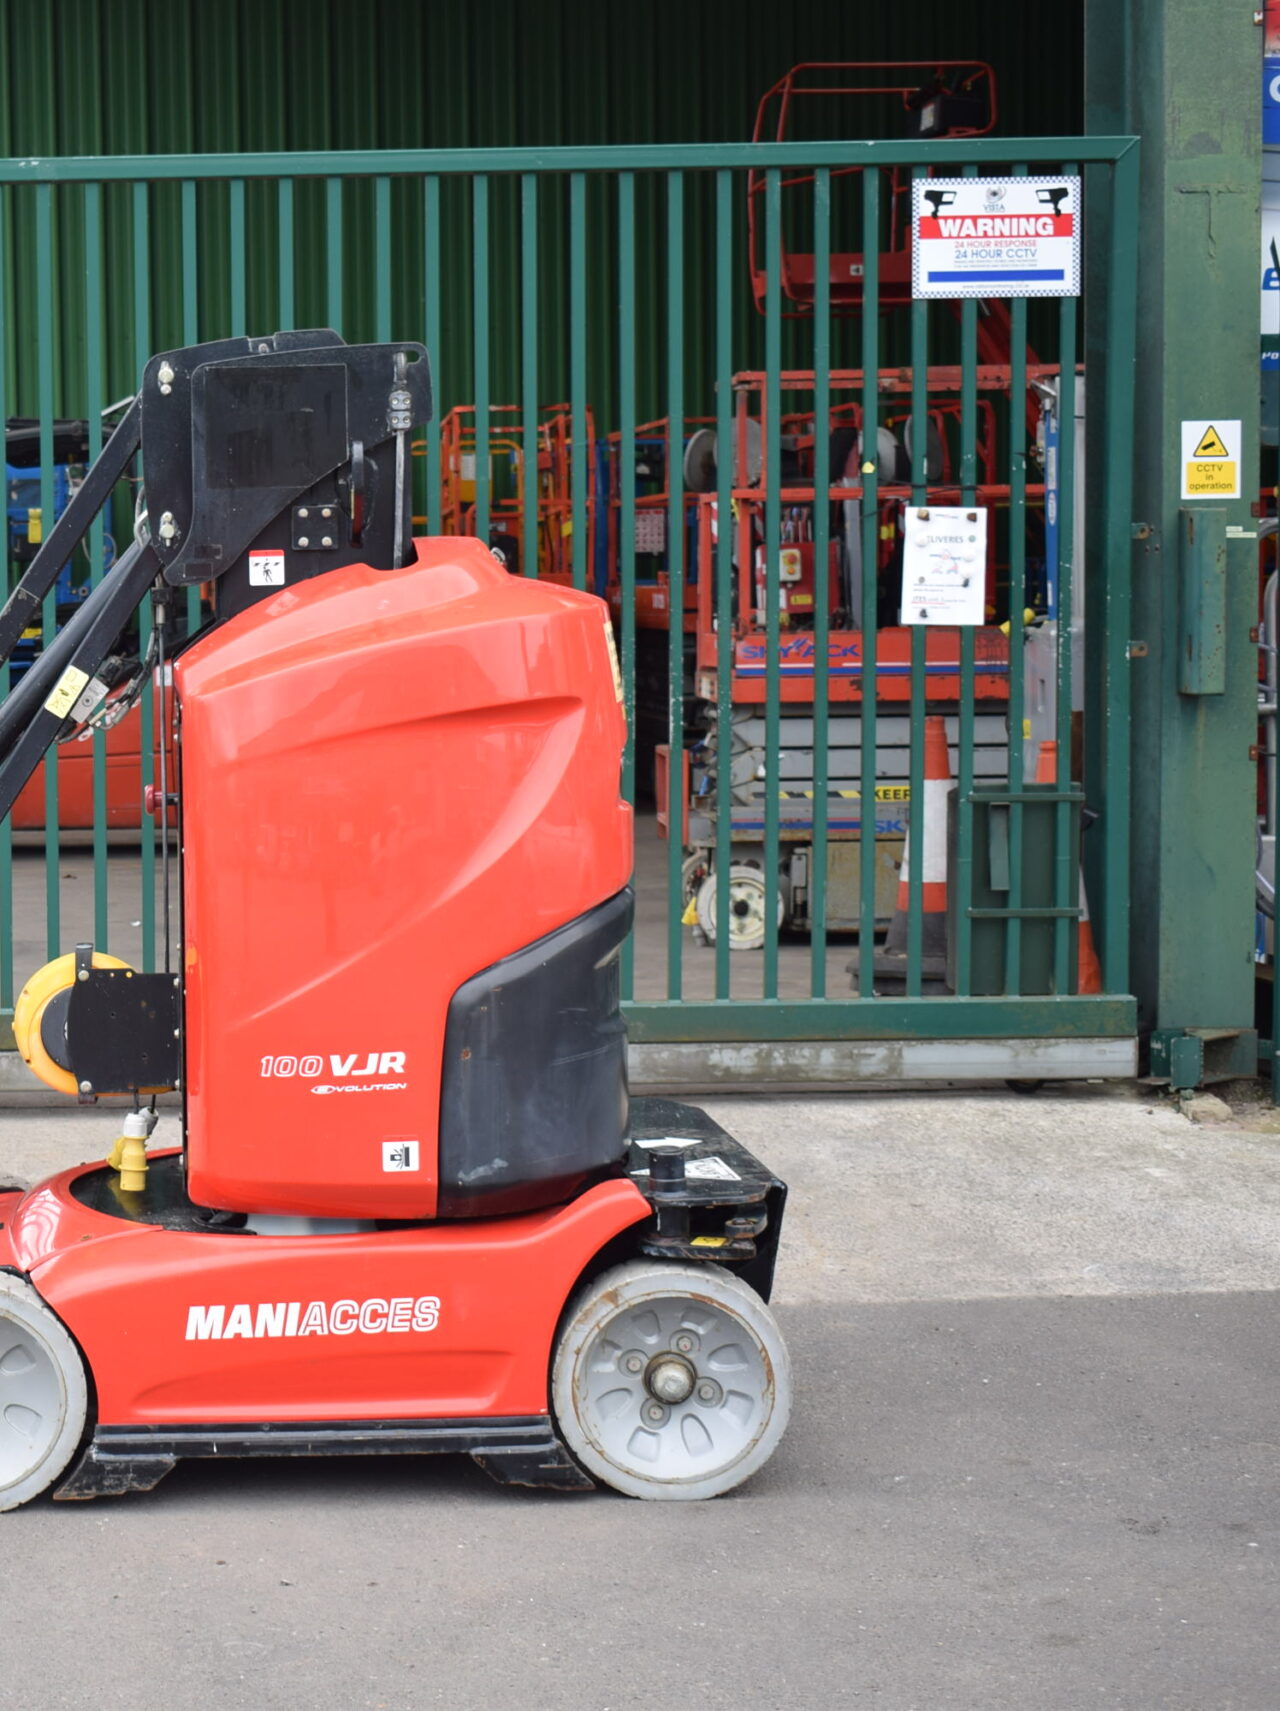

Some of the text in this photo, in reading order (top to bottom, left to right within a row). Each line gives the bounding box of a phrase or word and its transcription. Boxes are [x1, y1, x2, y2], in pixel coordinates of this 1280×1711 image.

[938, 217, 1054, 237] WARNING
[954, 239, 1037, 249] 24 HOUR RESPONSE
[955, 248, 1037, 259] 24 HOUR CCTV
[1196, 464, 1223, 472] CCTV
[1189, 482, 1232, 490] operation
[260, 1051, 406, 1077] 100 VJR
[185, 1296, 440, 1340] MANIACCES
